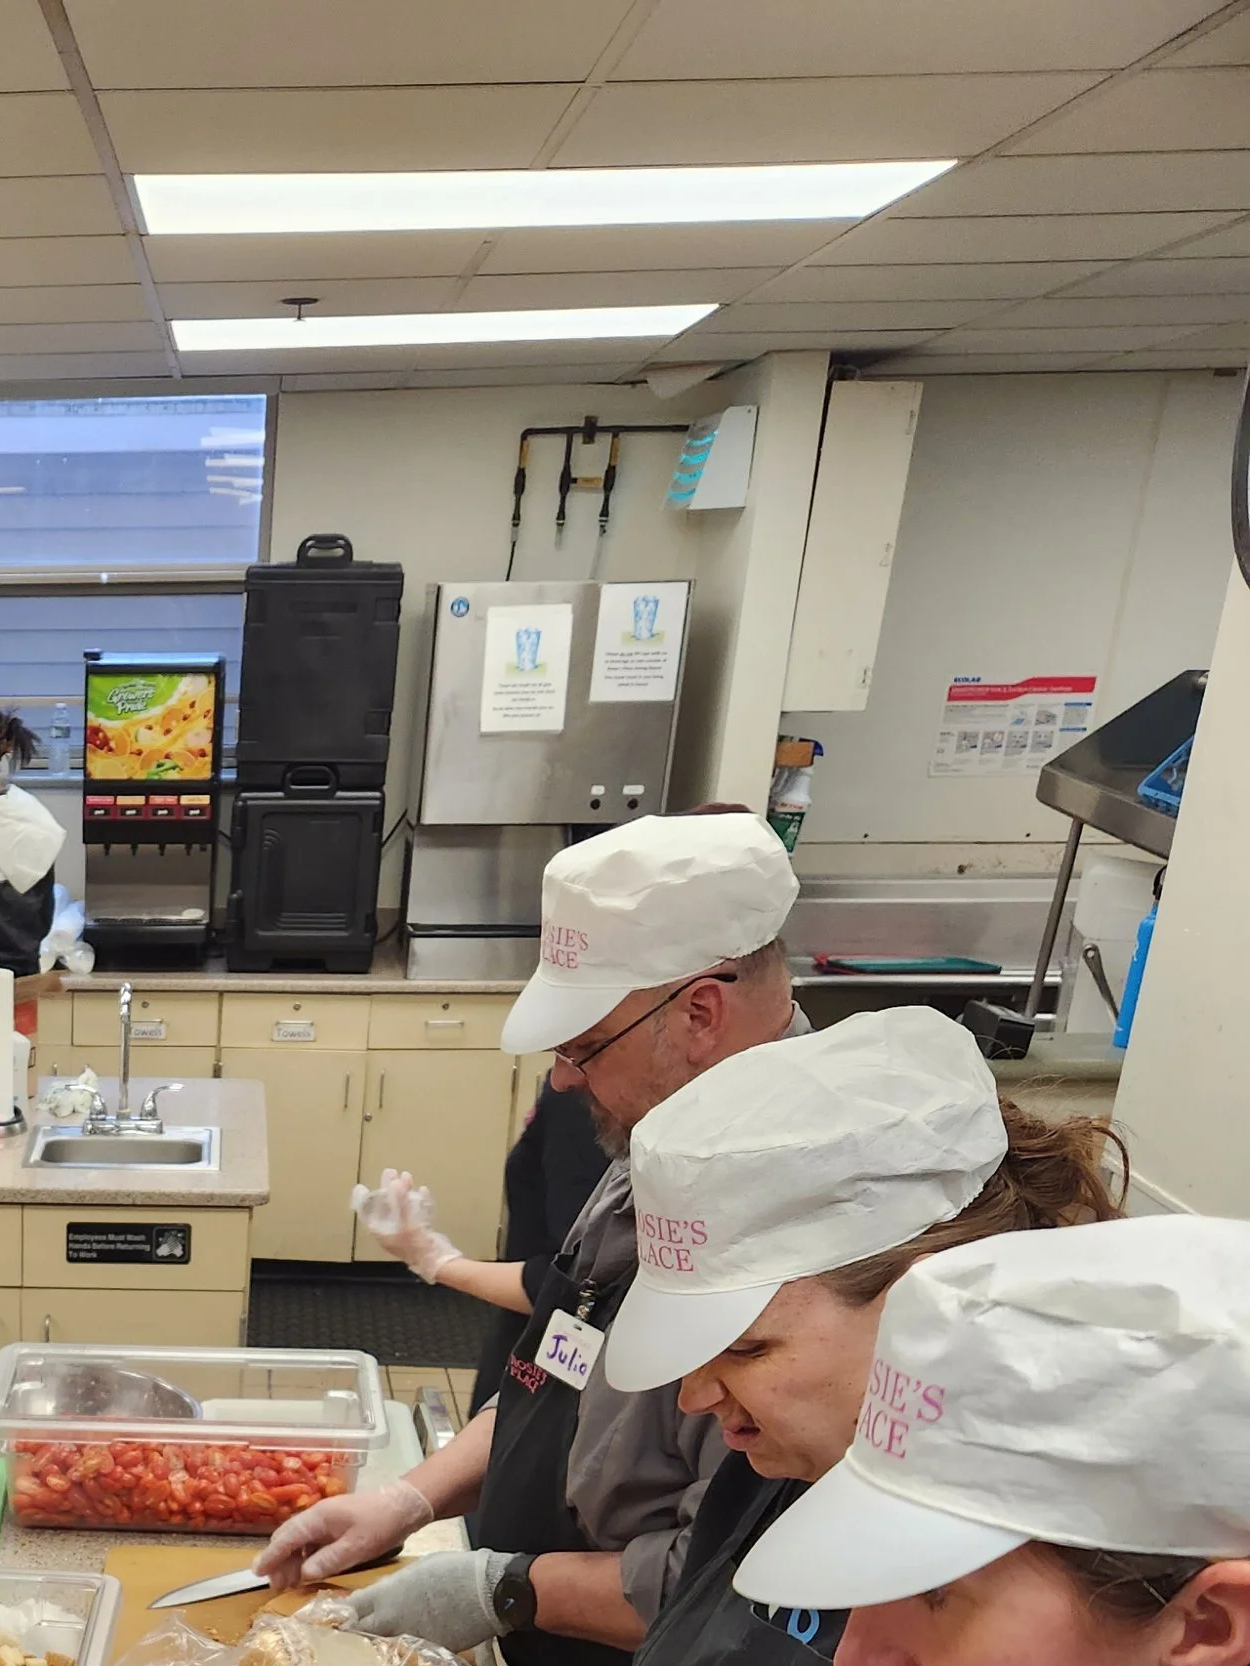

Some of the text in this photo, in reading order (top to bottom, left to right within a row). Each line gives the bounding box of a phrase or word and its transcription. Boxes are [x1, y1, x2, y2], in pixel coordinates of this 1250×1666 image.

[542, 945, 578, 969] LACE
[638, 1208, 708, 1246] OSIE'S
[638, 1241, 694, 1272] LACE
[869, 1358, 946, 1425] SIE'S
[858, 1401, 910, 1459] ACE
